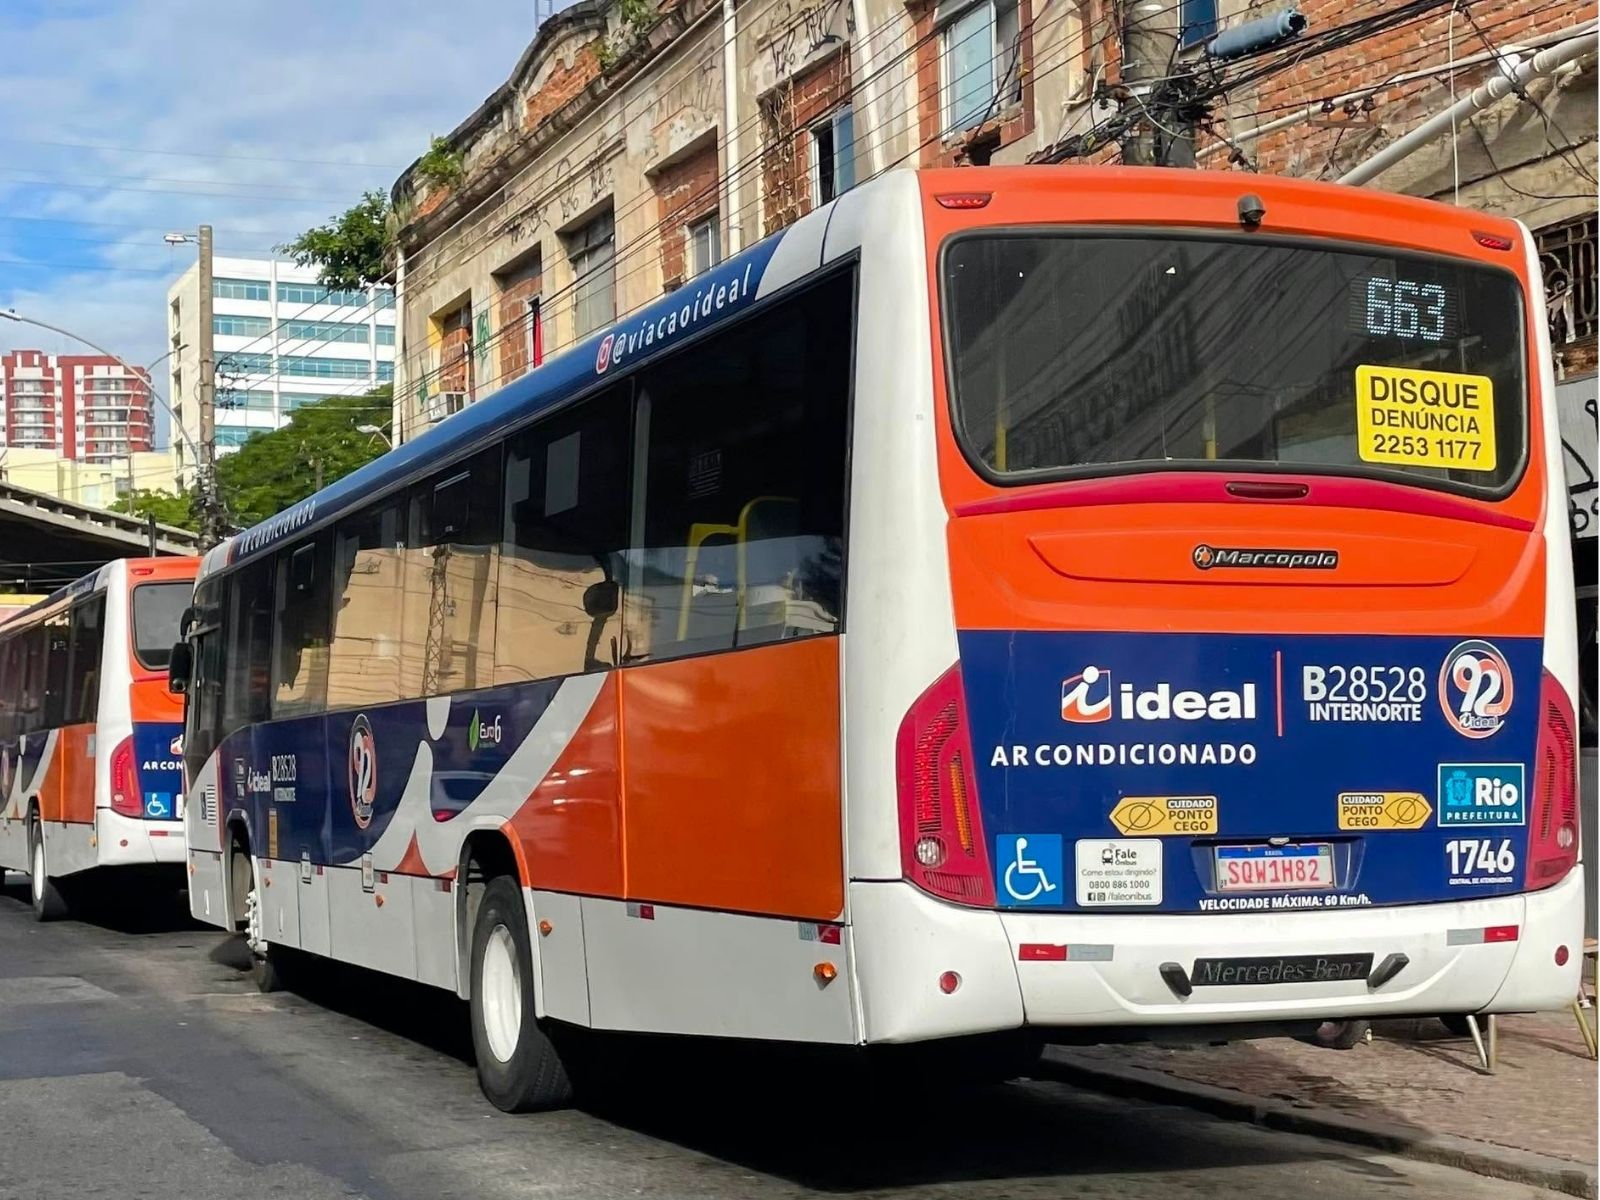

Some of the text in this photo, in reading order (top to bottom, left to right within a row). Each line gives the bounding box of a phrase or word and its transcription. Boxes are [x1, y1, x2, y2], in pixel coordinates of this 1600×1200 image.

[612, 263, 752, 364] @viacaoideal
[1367, 277, 1446, 341] 663
[1370, 376, 1480, 409] DISQUE
[1371, 408, 1481, 435] DENÚNCIA
[1373, 434, 1482, 461] 2253 1177
[1215, 550, 1337, 568] Marcopolo
[1302, 665, 1427, 703] B28528
[1120, 683, 1256, 720] ideal
[1309, 703, 1422, 722] INTERNORTE
[990, 743, 1257, 767] AR CONDICIONADO
[142, 761, 159, 770] AR
[1342, 796, 1384, 805] CUIDADO
[1475, 777, 1519, 807] Rio
[1167, 799, 1213, 809] CUIDADO
[1342, 806, 1383, 816] PONTO
[1168, 810, 1213, 821] PONTO
[1347, 816, 1379, 827] CEGO
[1446, 811, 1519, 821] PREFEITURA
[1173, 821, 1209, 832] CEGO
[1114, 848, 1137, 860] Fale
[1445, 839, 1515, 875] 1746
[1227, 859, 1320, 885] SQW1H82
[1089, 880, 1110, 889] 0800
[1130, 880, 1150, 889] 1000
[1199, 894, 1372, 911] VELOCIDADE MÁXIMA: 60 Km/h.
[1203, 958, 1365, 983] Mercedes-Benz
